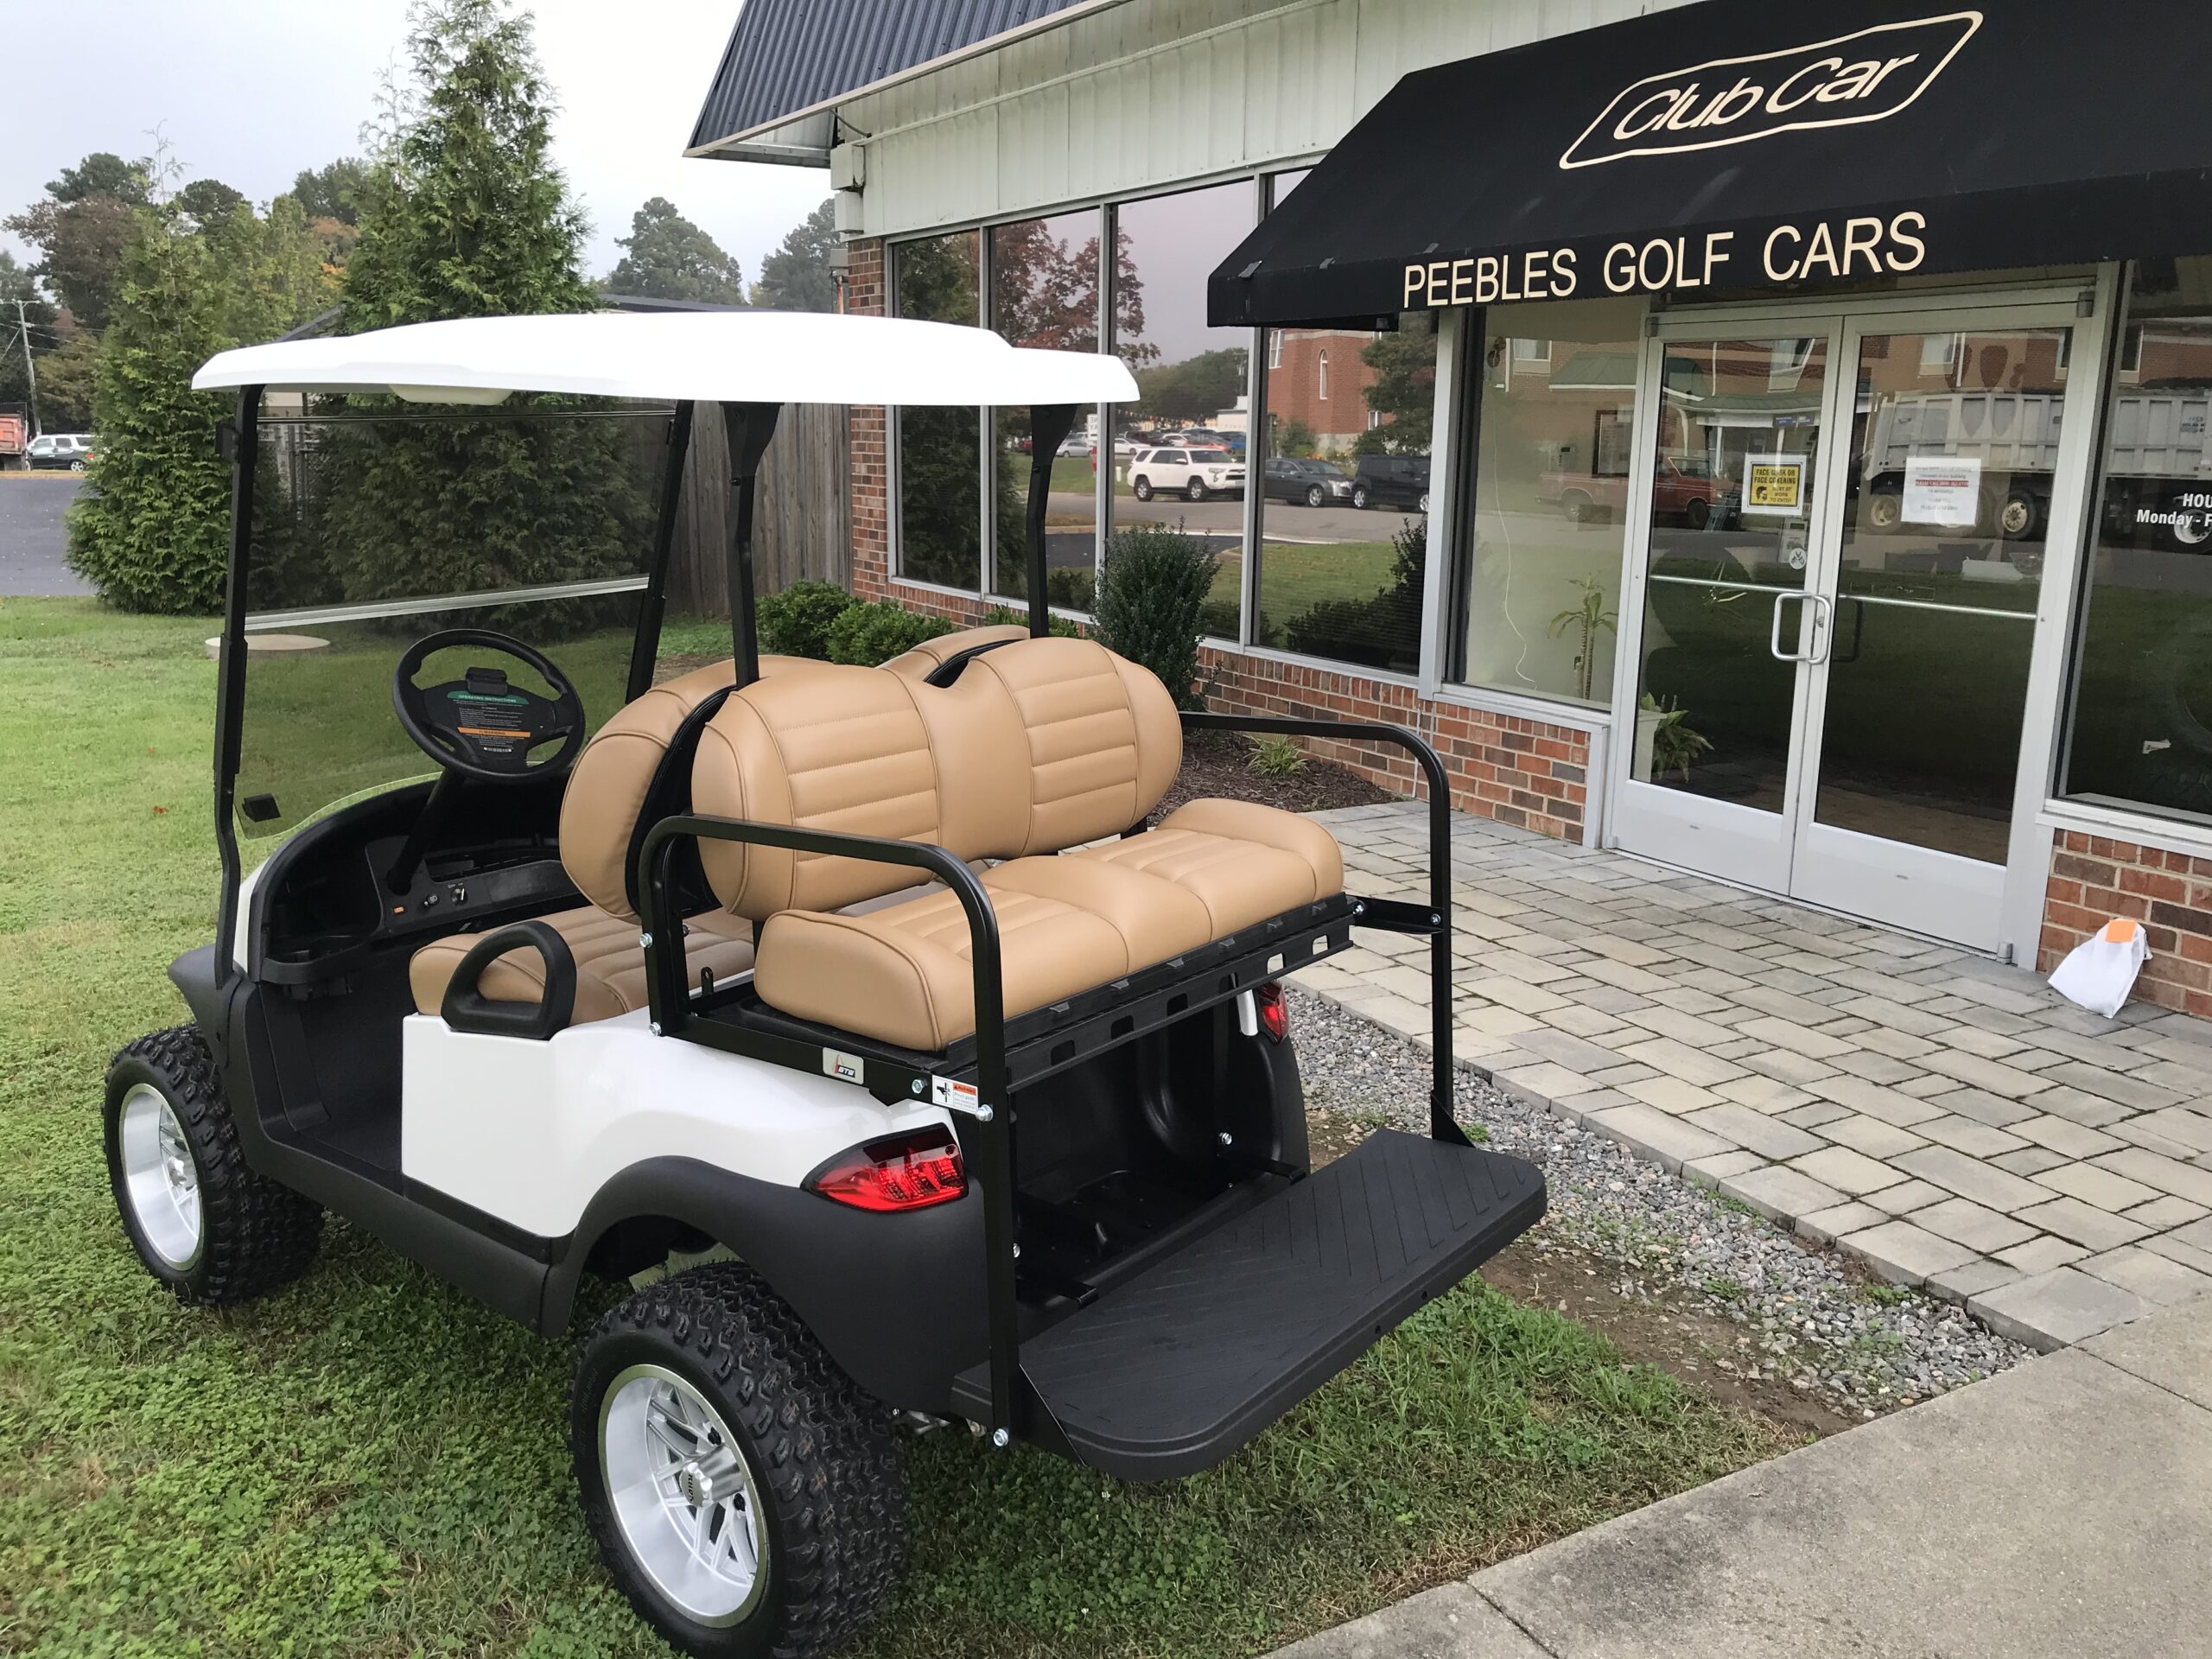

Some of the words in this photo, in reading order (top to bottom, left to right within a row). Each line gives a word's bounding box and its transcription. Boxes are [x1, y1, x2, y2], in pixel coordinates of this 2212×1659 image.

[1613, 77, 1764, 139] Club
[1766, 54, 1919, 113] Car
[1403, 248, 1577, 308] PEEBLES
[1603, 231, 1734, 293] GOLF
[1763, 211, 1926, 281] CARS
[2136, 509, 2194, 529] Monday
